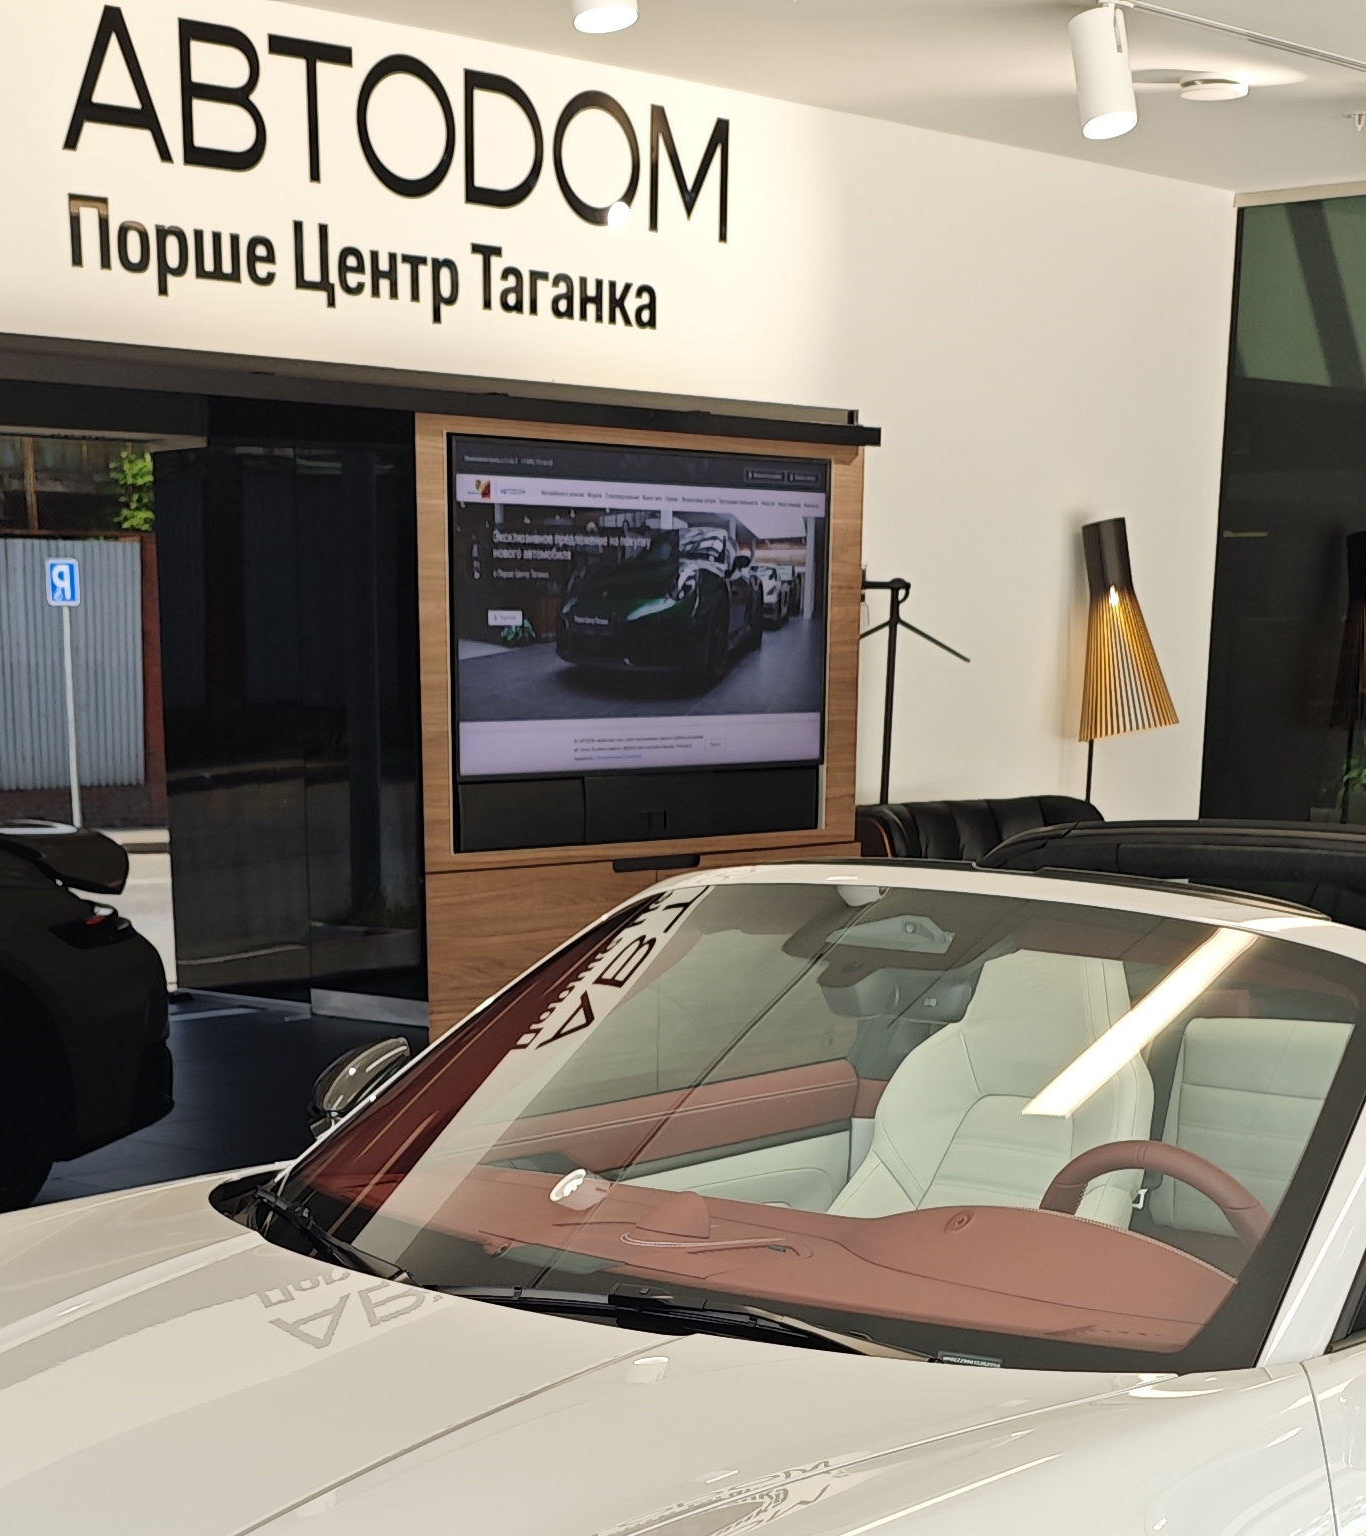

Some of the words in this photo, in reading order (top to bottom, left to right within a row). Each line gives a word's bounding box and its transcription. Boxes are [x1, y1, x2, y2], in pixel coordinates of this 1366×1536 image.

[67, 193, 276, 297] Порше
[292, 220, 460, 324] Центр
[470, 243, 658, 330] Таганка
